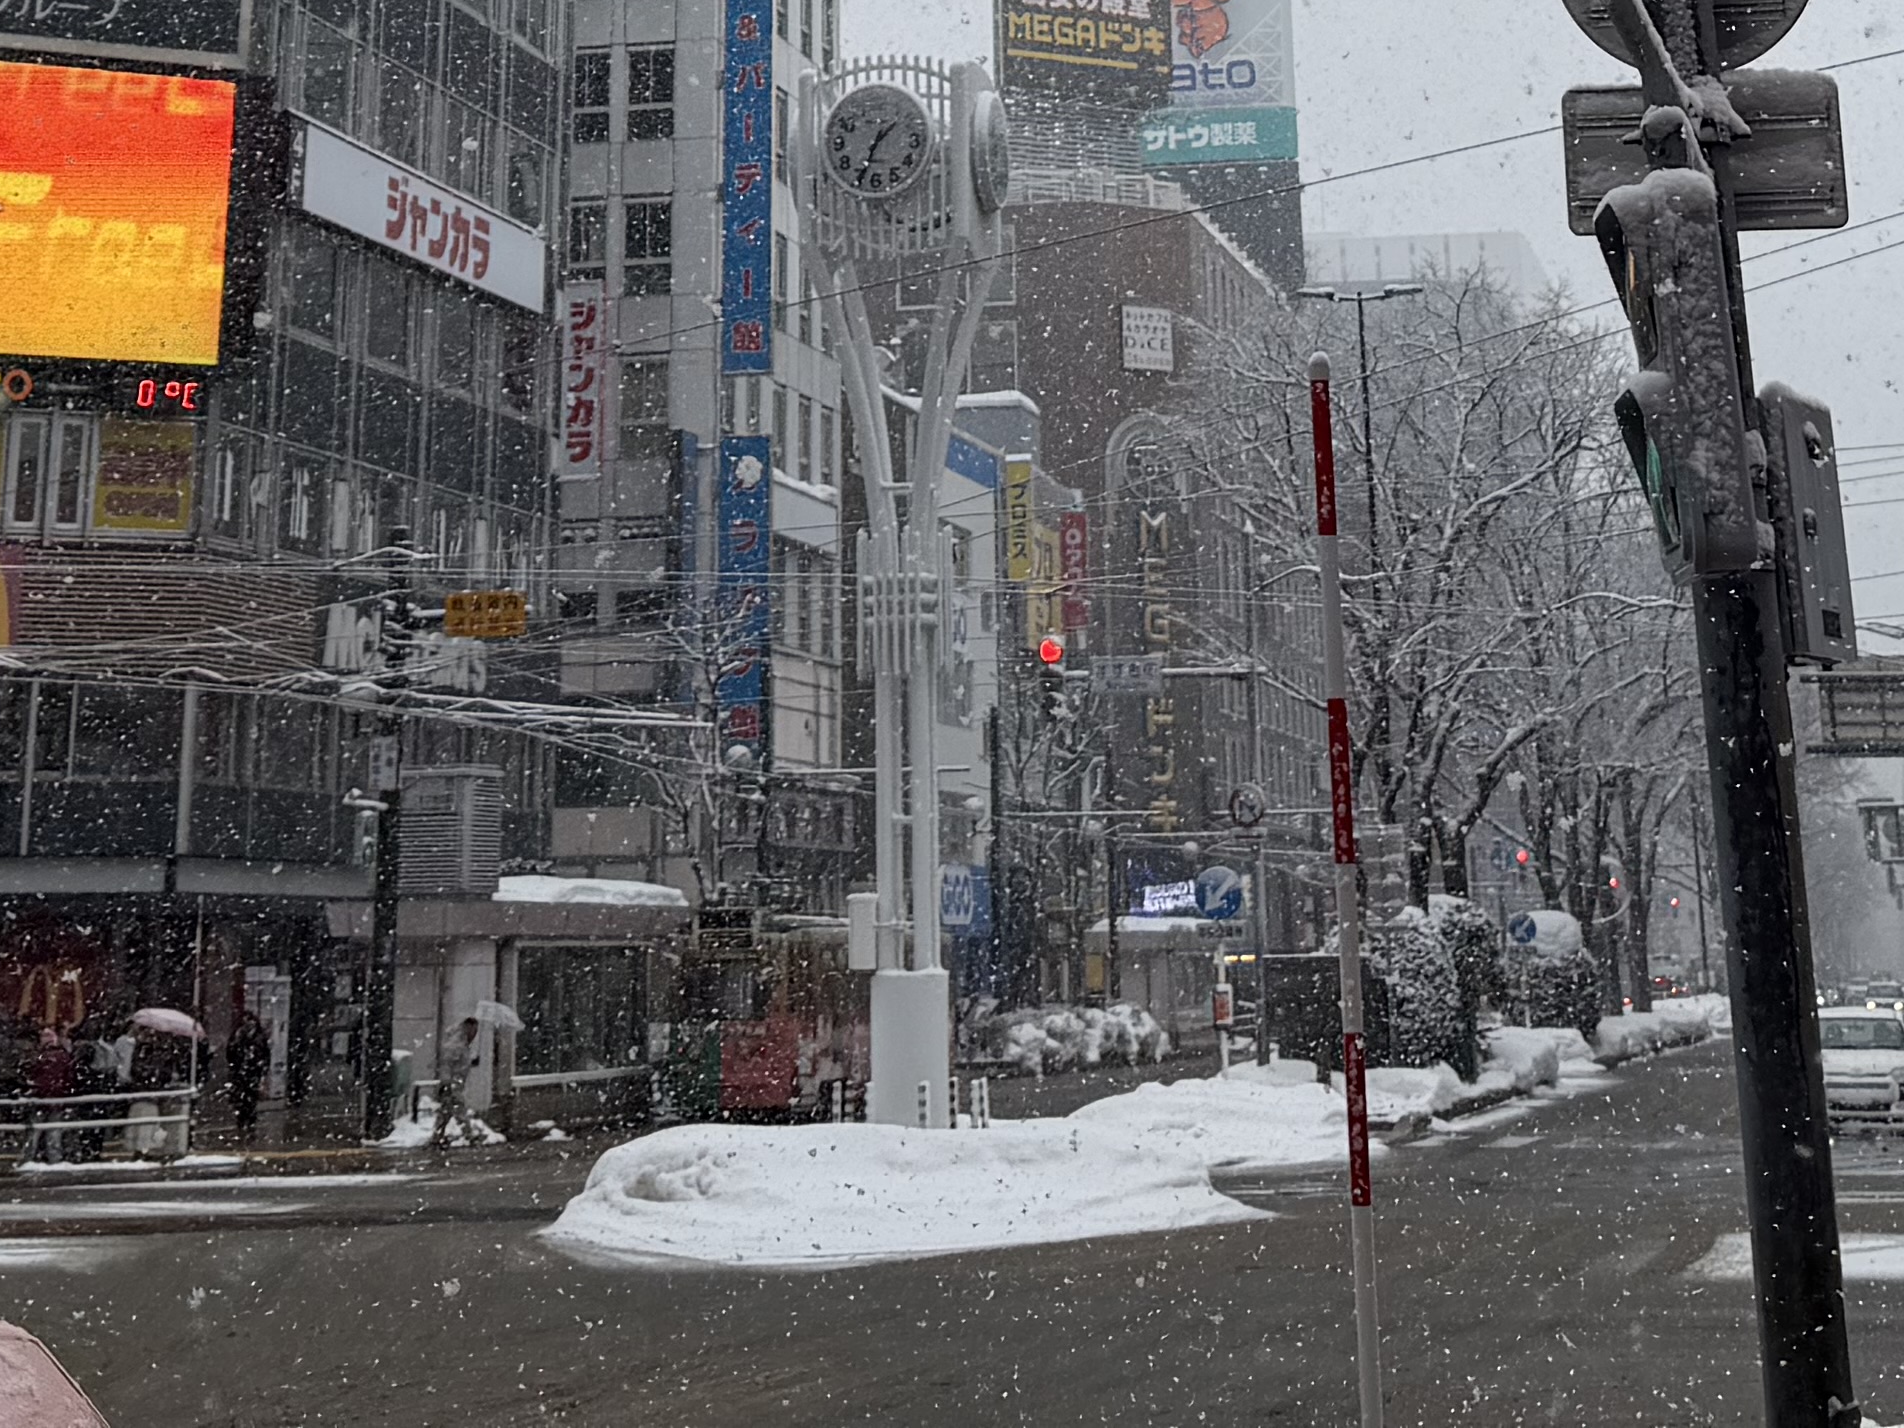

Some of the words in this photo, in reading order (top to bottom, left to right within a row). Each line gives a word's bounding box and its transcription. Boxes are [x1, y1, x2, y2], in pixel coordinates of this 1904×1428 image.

[1007, 11, 1167, 57] MEGAドンキ
[1171, 58, 1257, 94] ato
[1141, 119, 1258, 152] サトウ製薬
[383, 174, 491, 281] ジャンカラ
[565, 300, 596, 464] ジャンカラ
